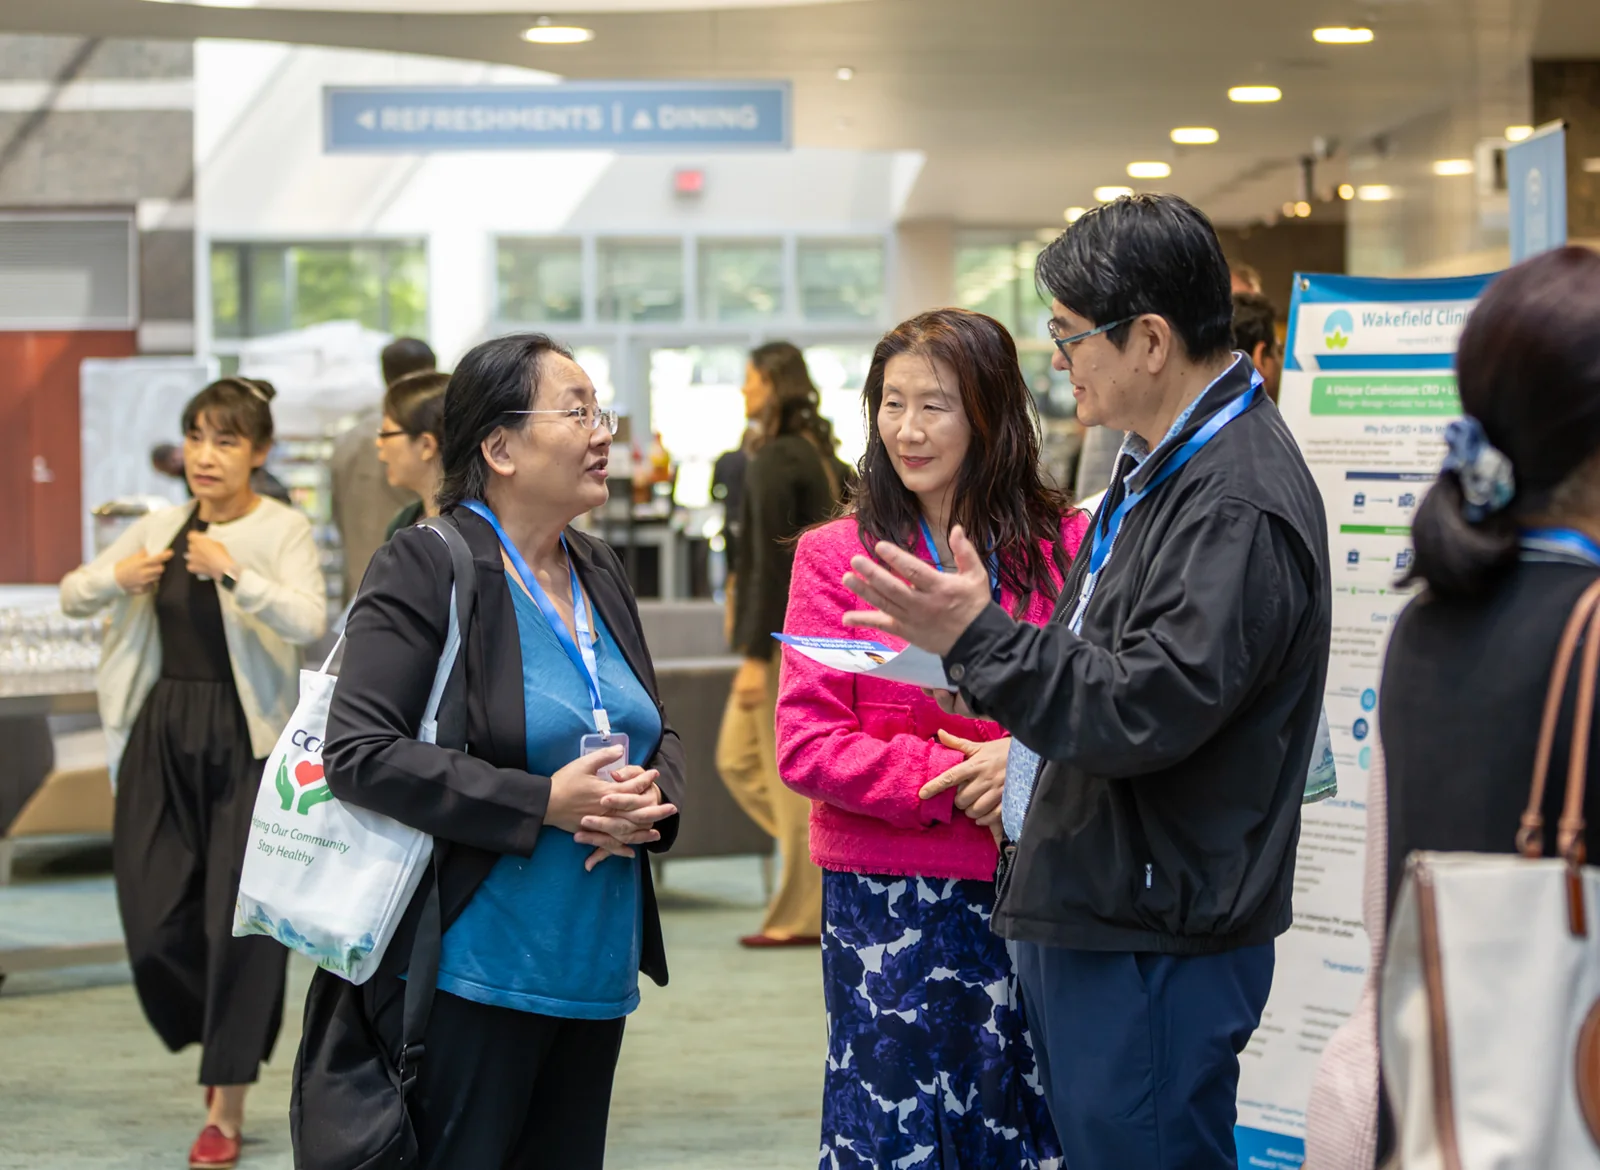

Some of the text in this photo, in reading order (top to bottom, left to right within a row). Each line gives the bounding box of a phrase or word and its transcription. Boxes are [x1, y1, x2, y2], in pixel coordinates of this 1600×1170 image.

[381, 104, 758, 132] REFRESHMENTS DINING
[1362, 310, 1432, 327] Wakefield
[271, 823, 288, 837] Our
[290, 828, 350, 854] Community
[257, 839, 315, 866] Stay Healthy
